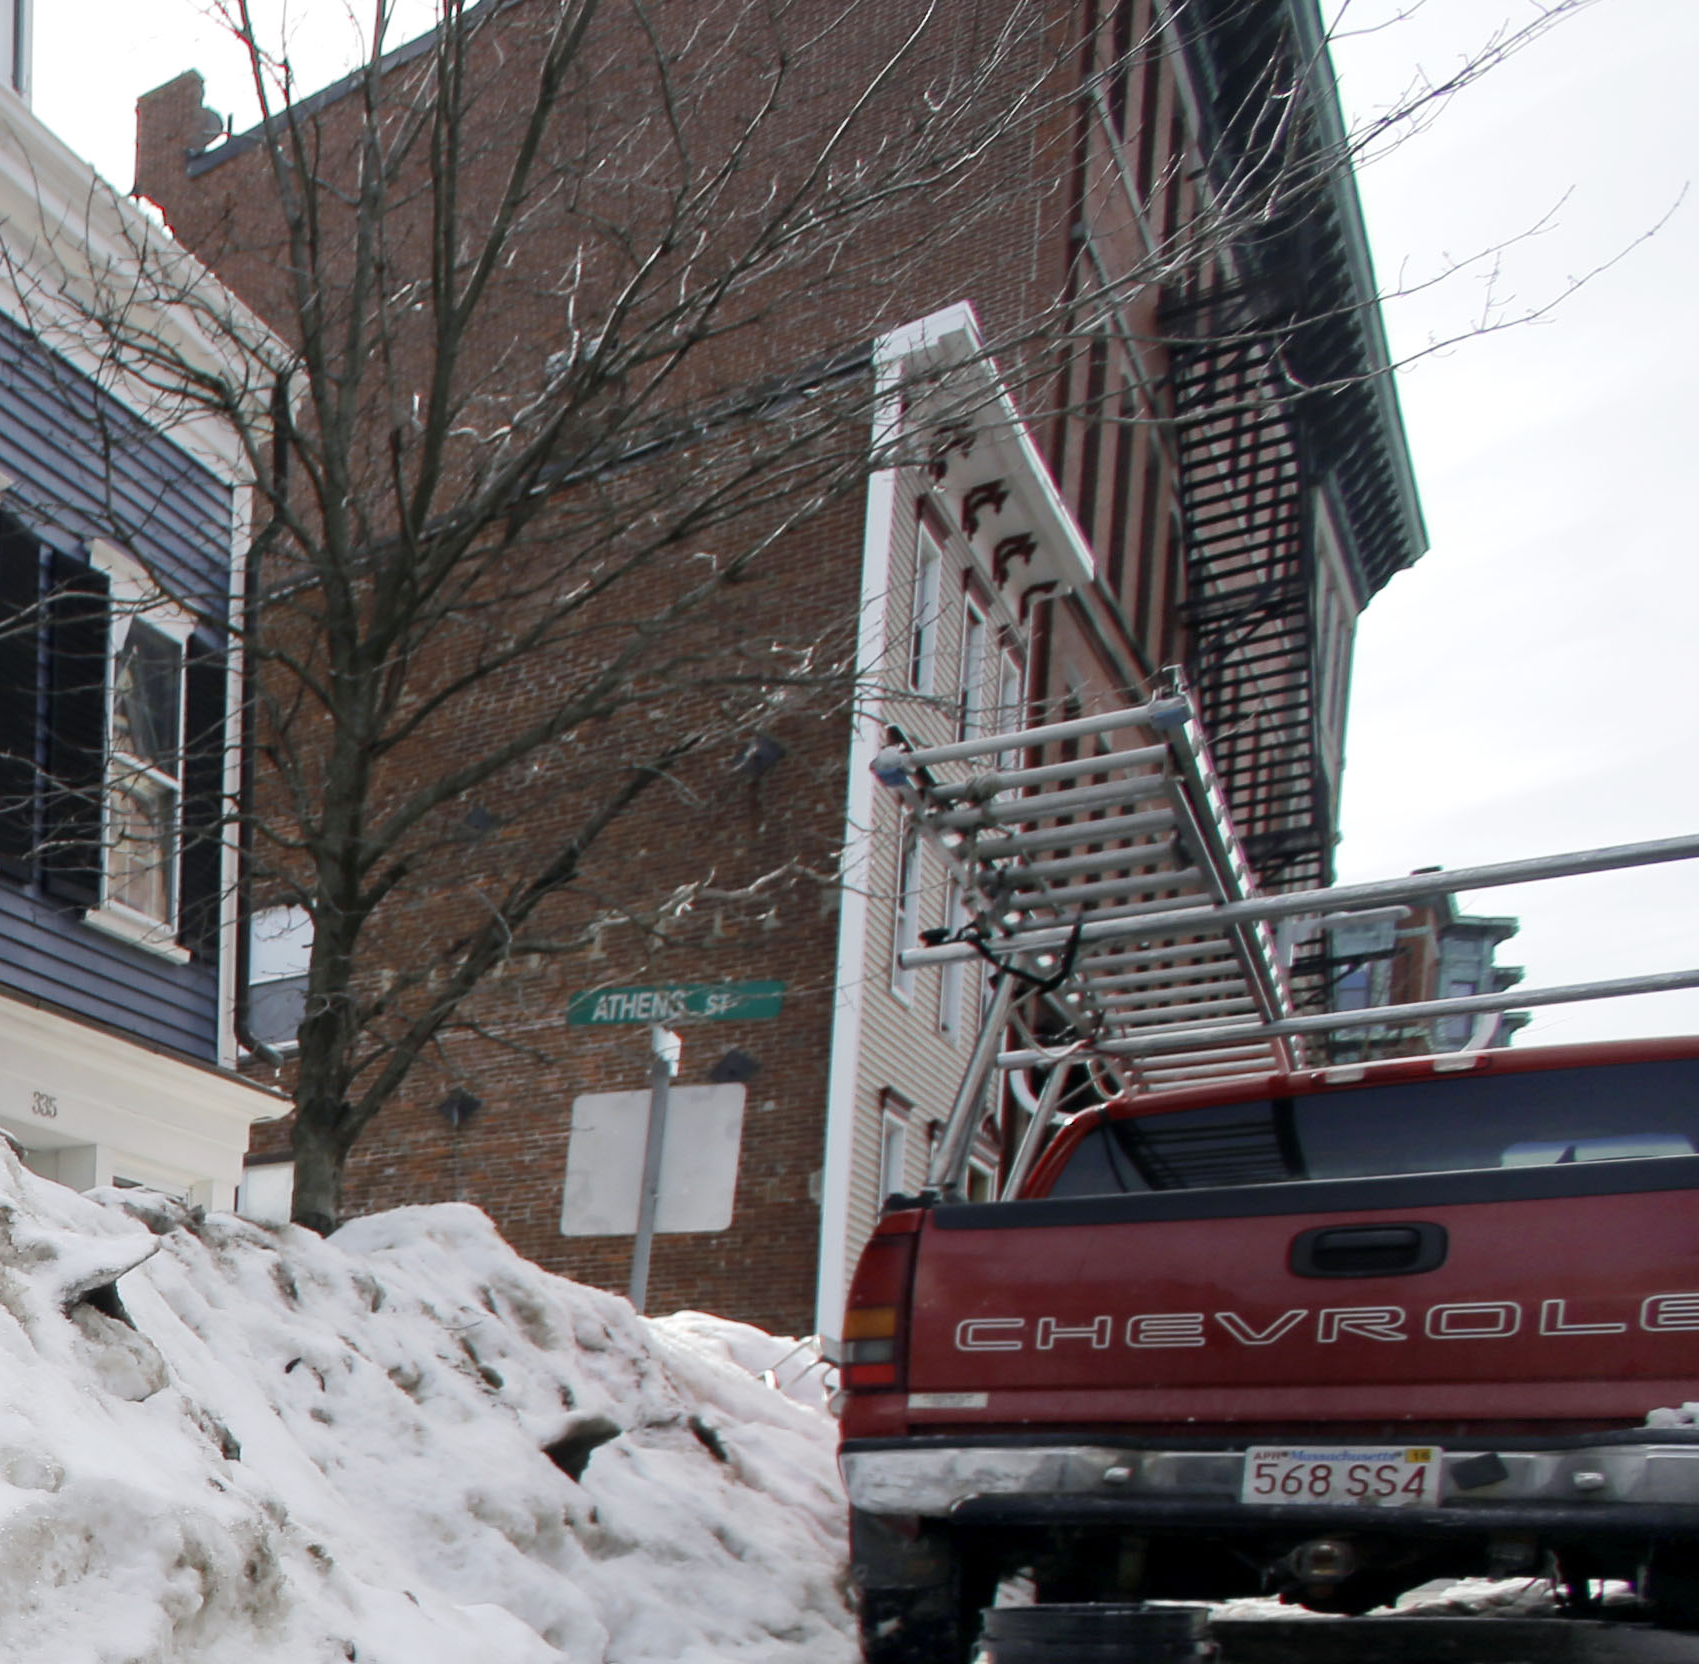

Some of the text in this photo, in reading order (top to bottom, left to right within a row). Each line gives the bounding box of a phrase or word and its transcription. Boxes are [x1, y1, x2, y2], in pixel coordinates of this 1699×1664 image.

[591, 990, 687, 1021] ATHENS
[32, 1091, 58, 1118] 335
[1254, 1463, 1427, 1498] 568 SS4
